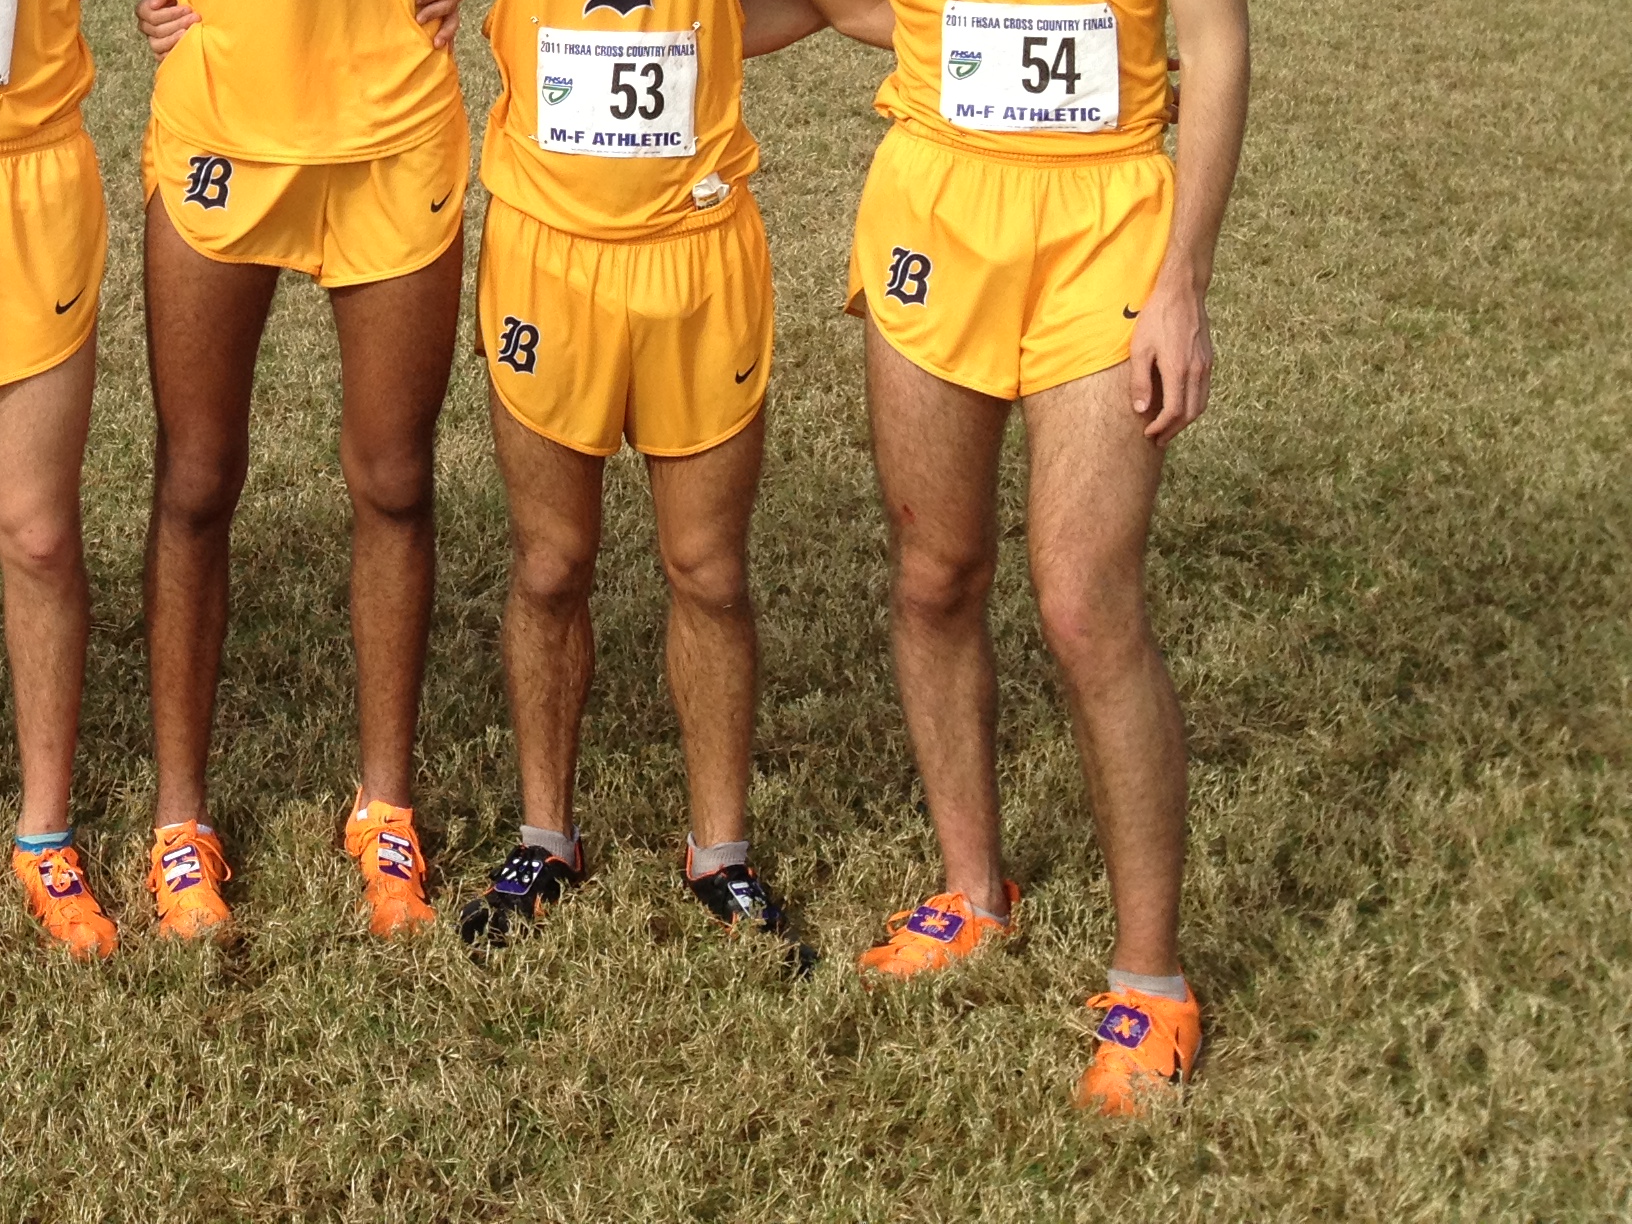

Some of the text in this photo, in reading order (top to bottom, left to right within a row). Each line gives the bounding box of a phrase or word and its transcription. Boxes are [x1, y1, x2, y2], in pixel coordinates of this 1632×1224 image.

[946, 15, 1114, 31] 2011 FHSAA CROSS COUNTRY FINALS
[541, 41, 695, 58] 2011 FHSAA CROSS COUNTRY FINALS
[950, 50, 982, 59] FHSAA
[1021, 36, 1081, 95] 54
[544, 76, 573, 85] FHSAA
[610, 62, 665, 120] 53
[956, 104, 1101, 122] M-F ATHLETIC
[550, 128, 682, 147] M-F ATHLETIC
[182, 155, 233, 211] B
[884, 246, 932, 308] B
[497, 315, 540, 377] B
